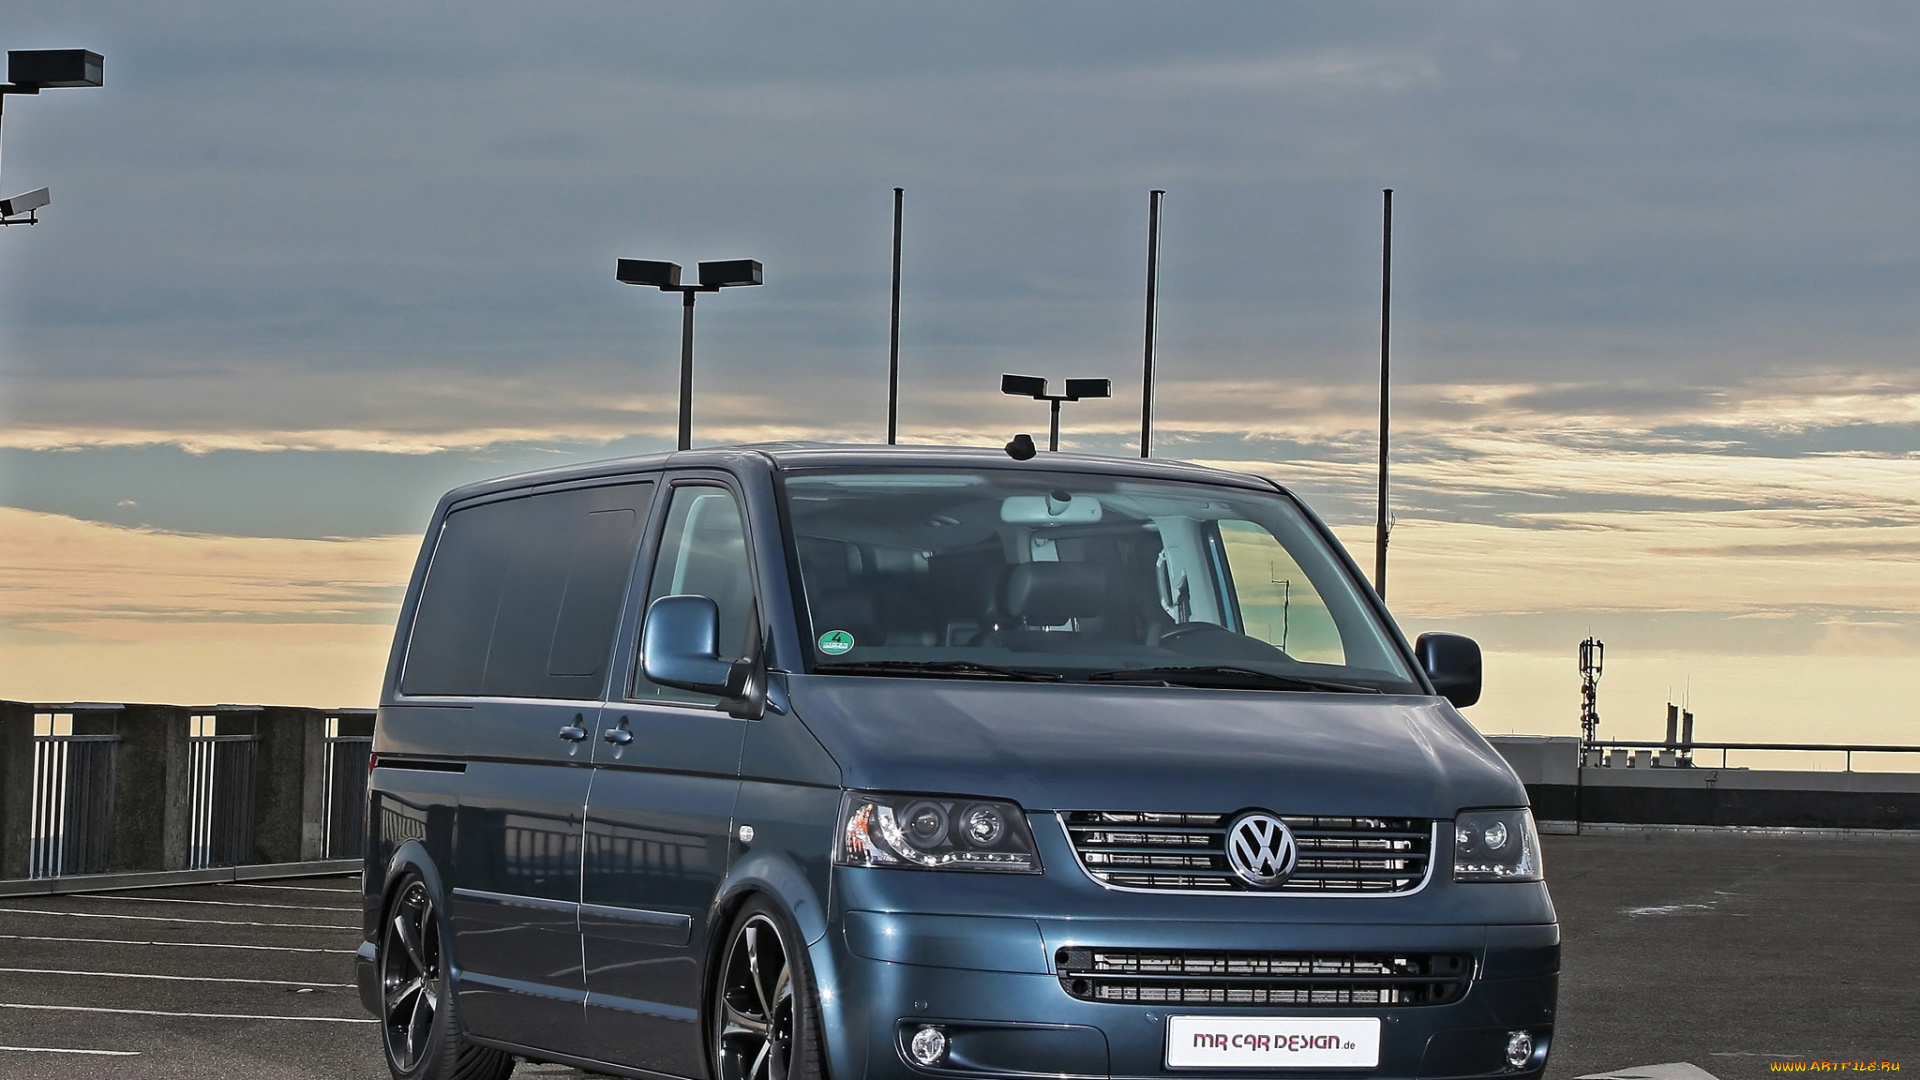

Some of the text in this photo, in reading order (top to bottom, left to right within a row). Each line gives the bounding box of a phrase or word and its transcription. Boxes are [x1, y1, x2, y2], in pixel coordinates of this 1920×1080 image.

[832, 632, 842, 642] 4
[1231, 816, 1294, 879] VW
[1193, 1033, 1228, 1051] MR
[1231, 1034, 1270, 1051] CAR
